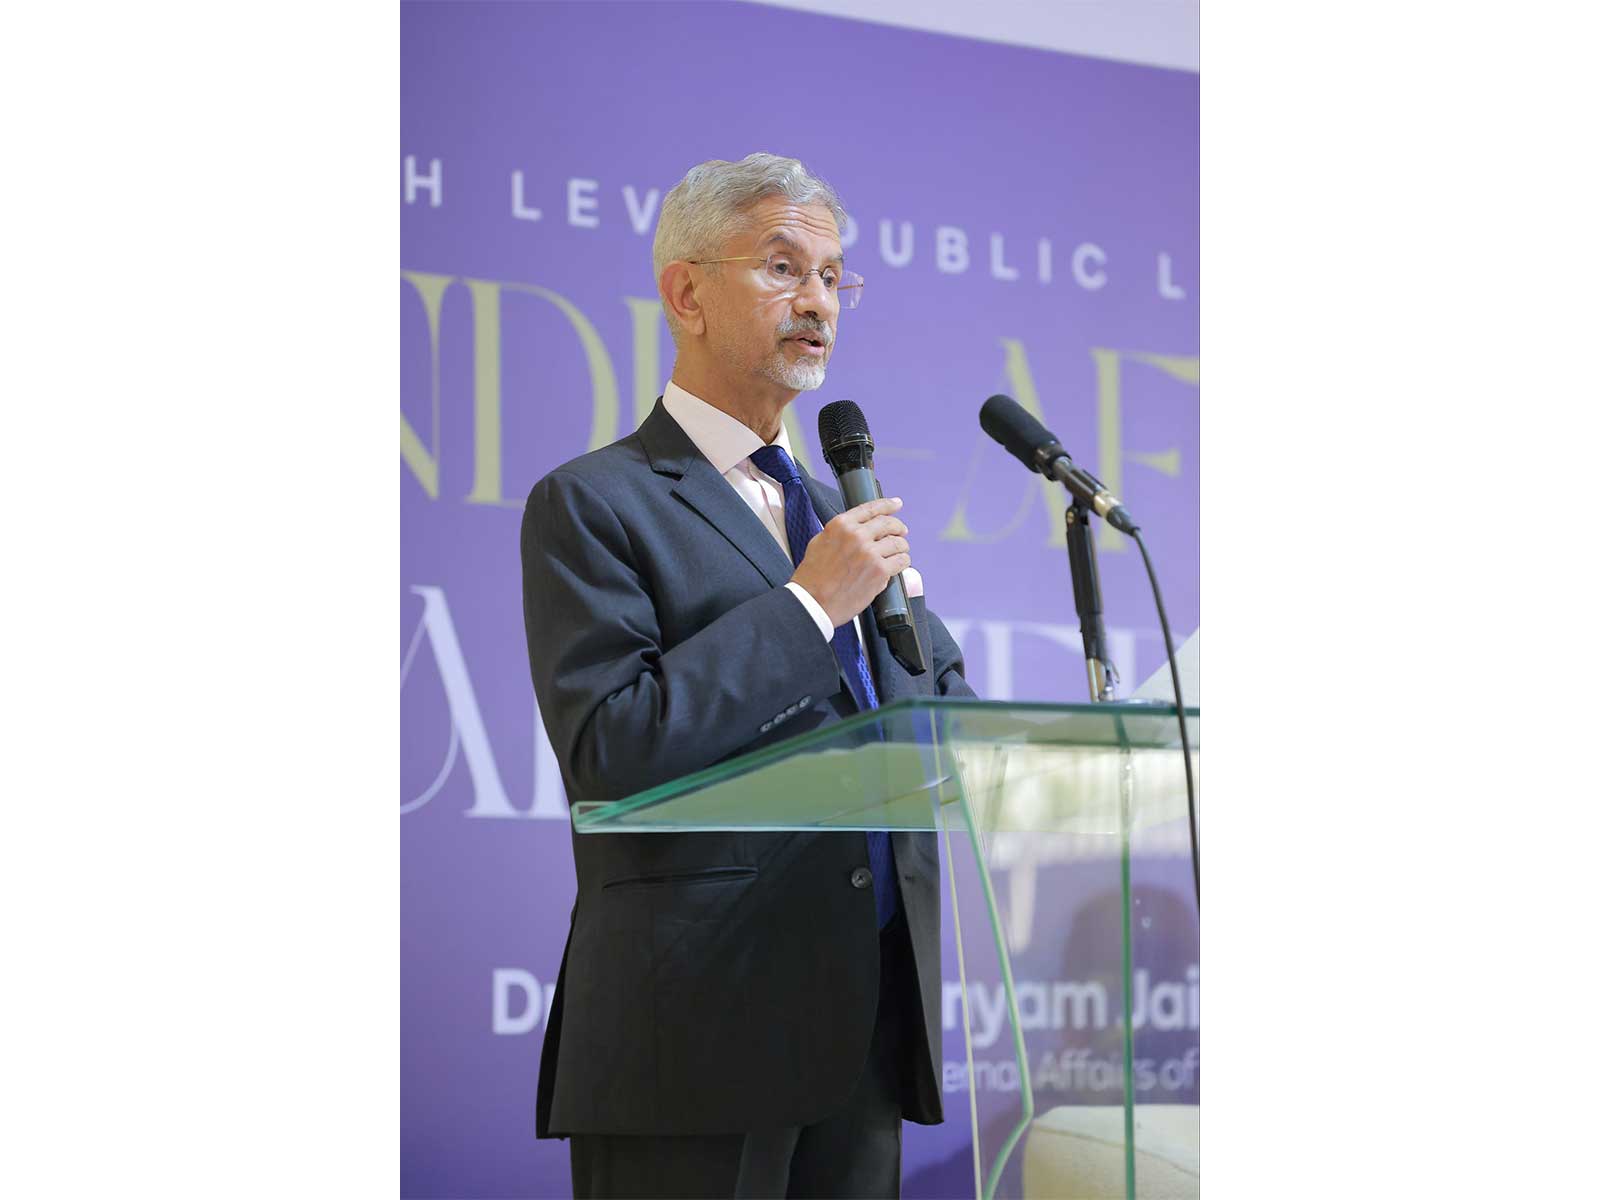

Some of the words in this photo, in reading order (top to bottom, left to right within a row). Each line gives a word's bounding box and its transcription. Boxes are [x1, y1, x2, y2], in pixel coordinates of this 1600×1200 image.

[511, 170, 661, 236] LEV
[941, 979, 1108, 1048] nyam
[1035, 1047, 1157, 1091] Affais
[1159, 1047, 1199, 1091] of
